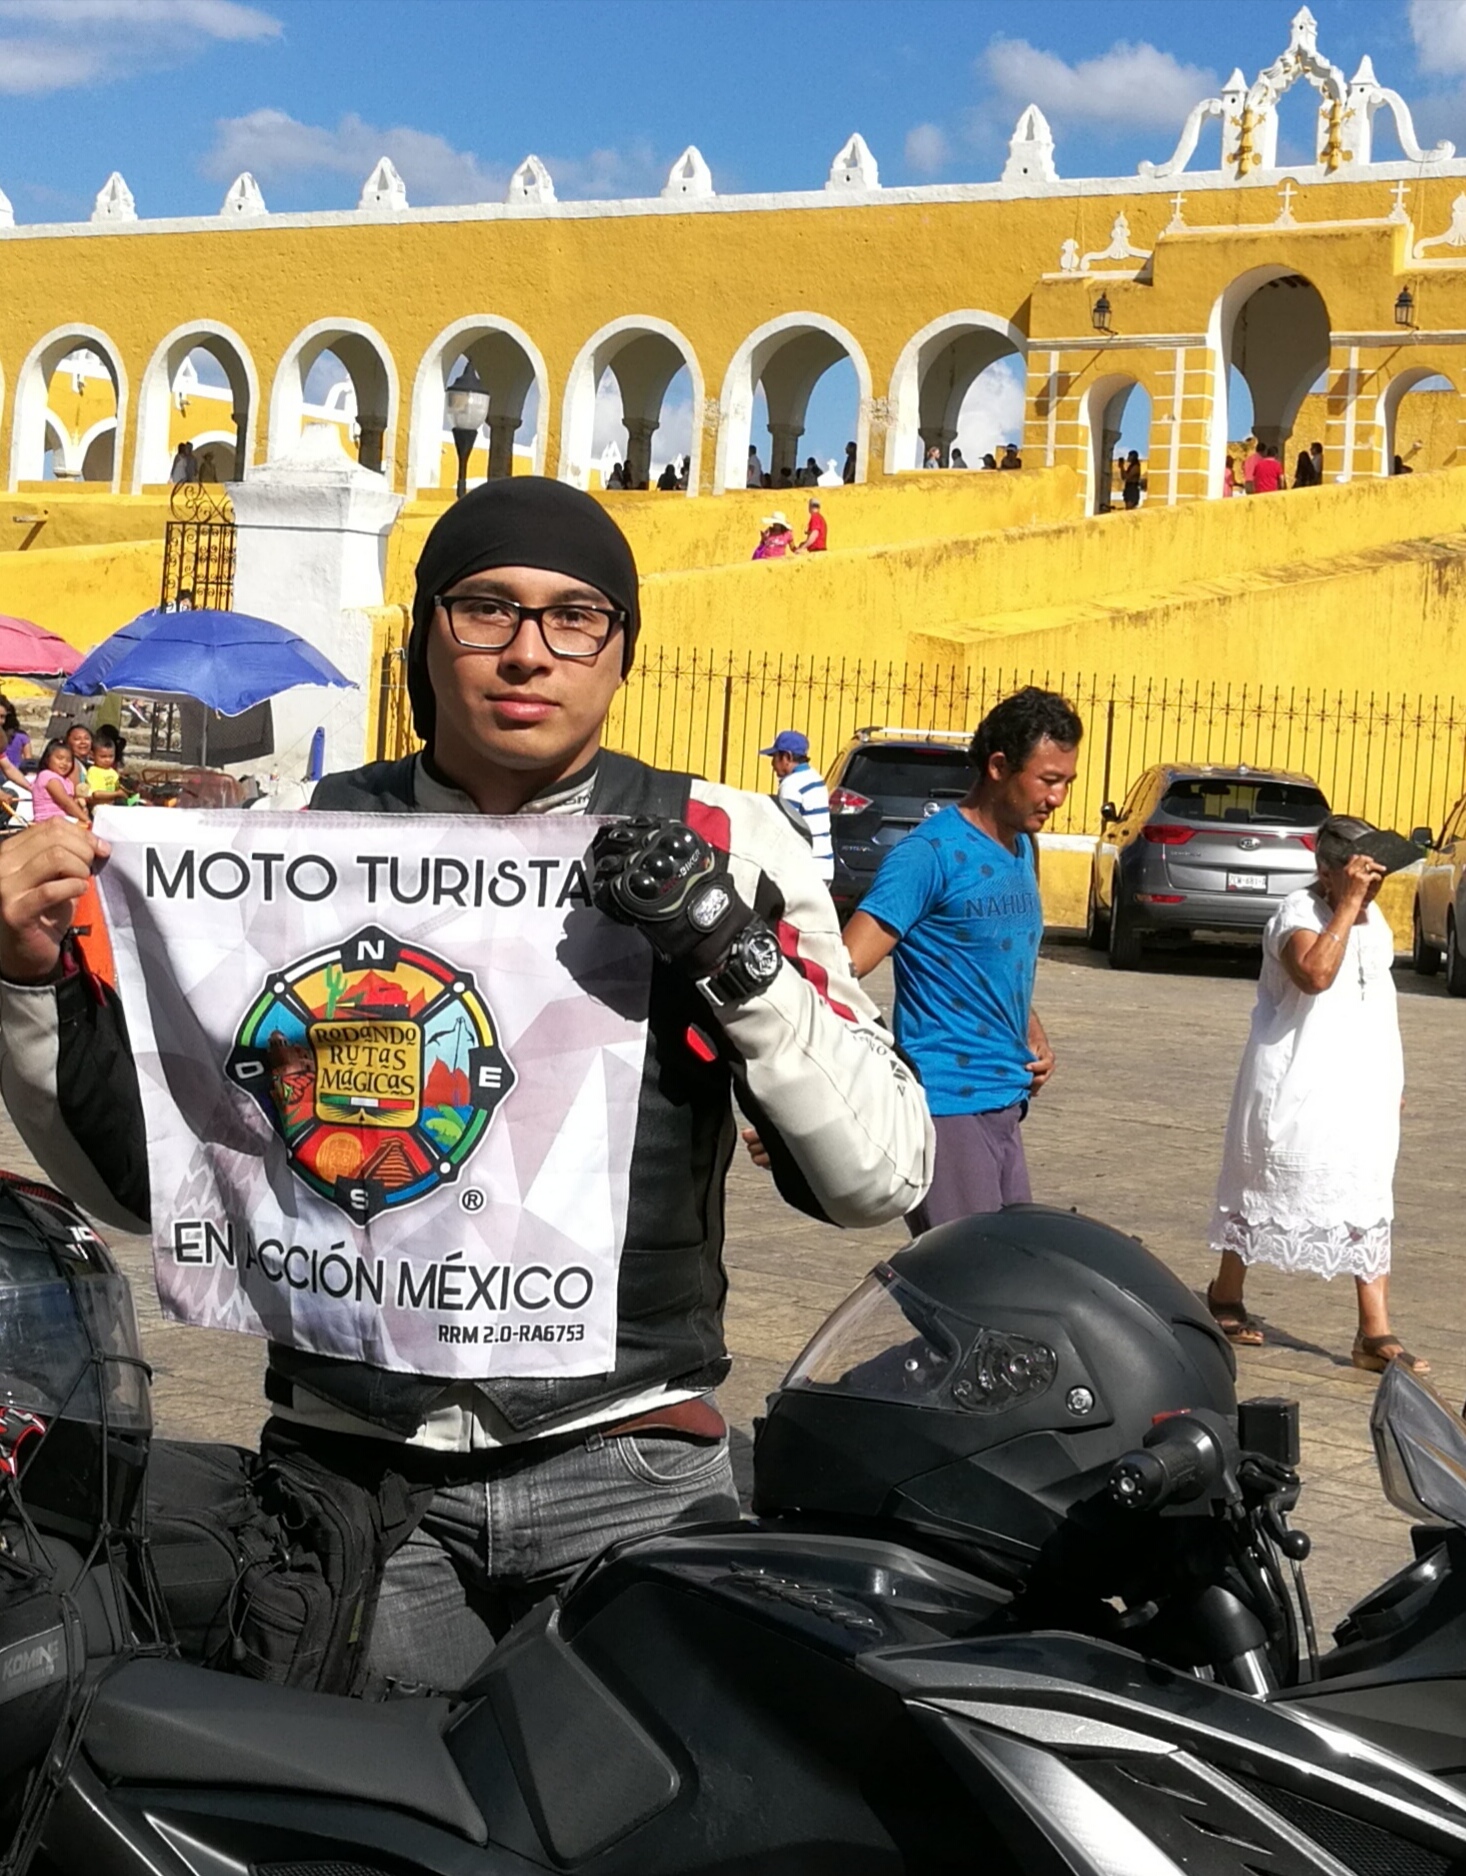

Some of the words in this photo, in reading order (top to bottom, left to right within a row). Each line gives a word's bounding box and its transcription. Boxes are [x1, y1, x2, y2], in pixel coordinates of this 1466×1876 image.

[146, 847, 338, 902] MOTO
[356, 855, 593, 908] TURISTA
[357, 940, 385, 961] N
[478, 1066, 502, 1088] E
[350, 1189, 369, 1210] S
[174, 1221, 236, 1267] EN
[397, 1251, 594, 1311] MÉXICO
[438, 1324, 479, 1344] RRM
[483, 1323, 585, 1344] 2.0-RA6753
